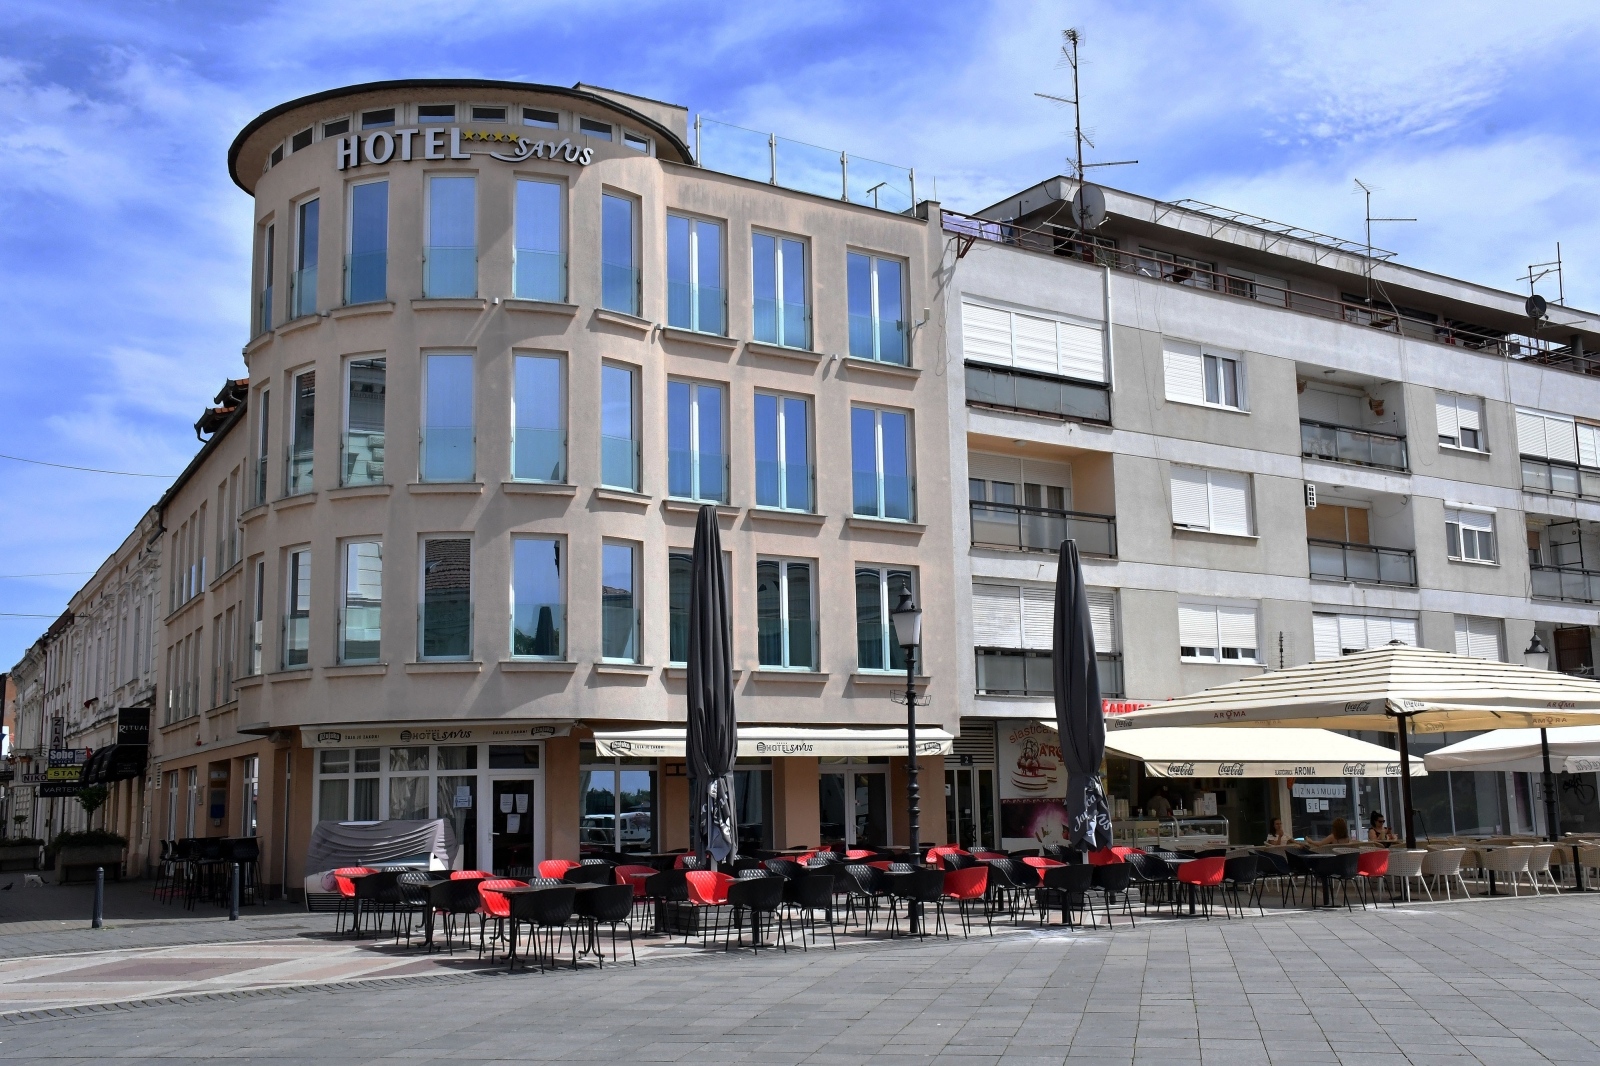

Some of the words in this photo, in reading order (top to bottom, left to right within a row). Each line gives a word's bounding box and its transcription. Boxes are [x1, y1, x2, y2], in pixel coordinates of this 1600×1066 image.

[337, 127, 471, 171] HOTEL
[490, 137, 594, 167] SAVUS
[1547, 701, 1575, 709] AROMA
[1214, 710, 1246, 719] AROMA
[119, 724, 148, 733] RITUAL
[412, 732, 441, 740] HOTEL
[434, 729, 472, 741] SAVUS
[784, 743, 813, 753] SAVUS
[50, 750, 73, 759] Sobe
[1295, 767, 1316, 775] AROMA
